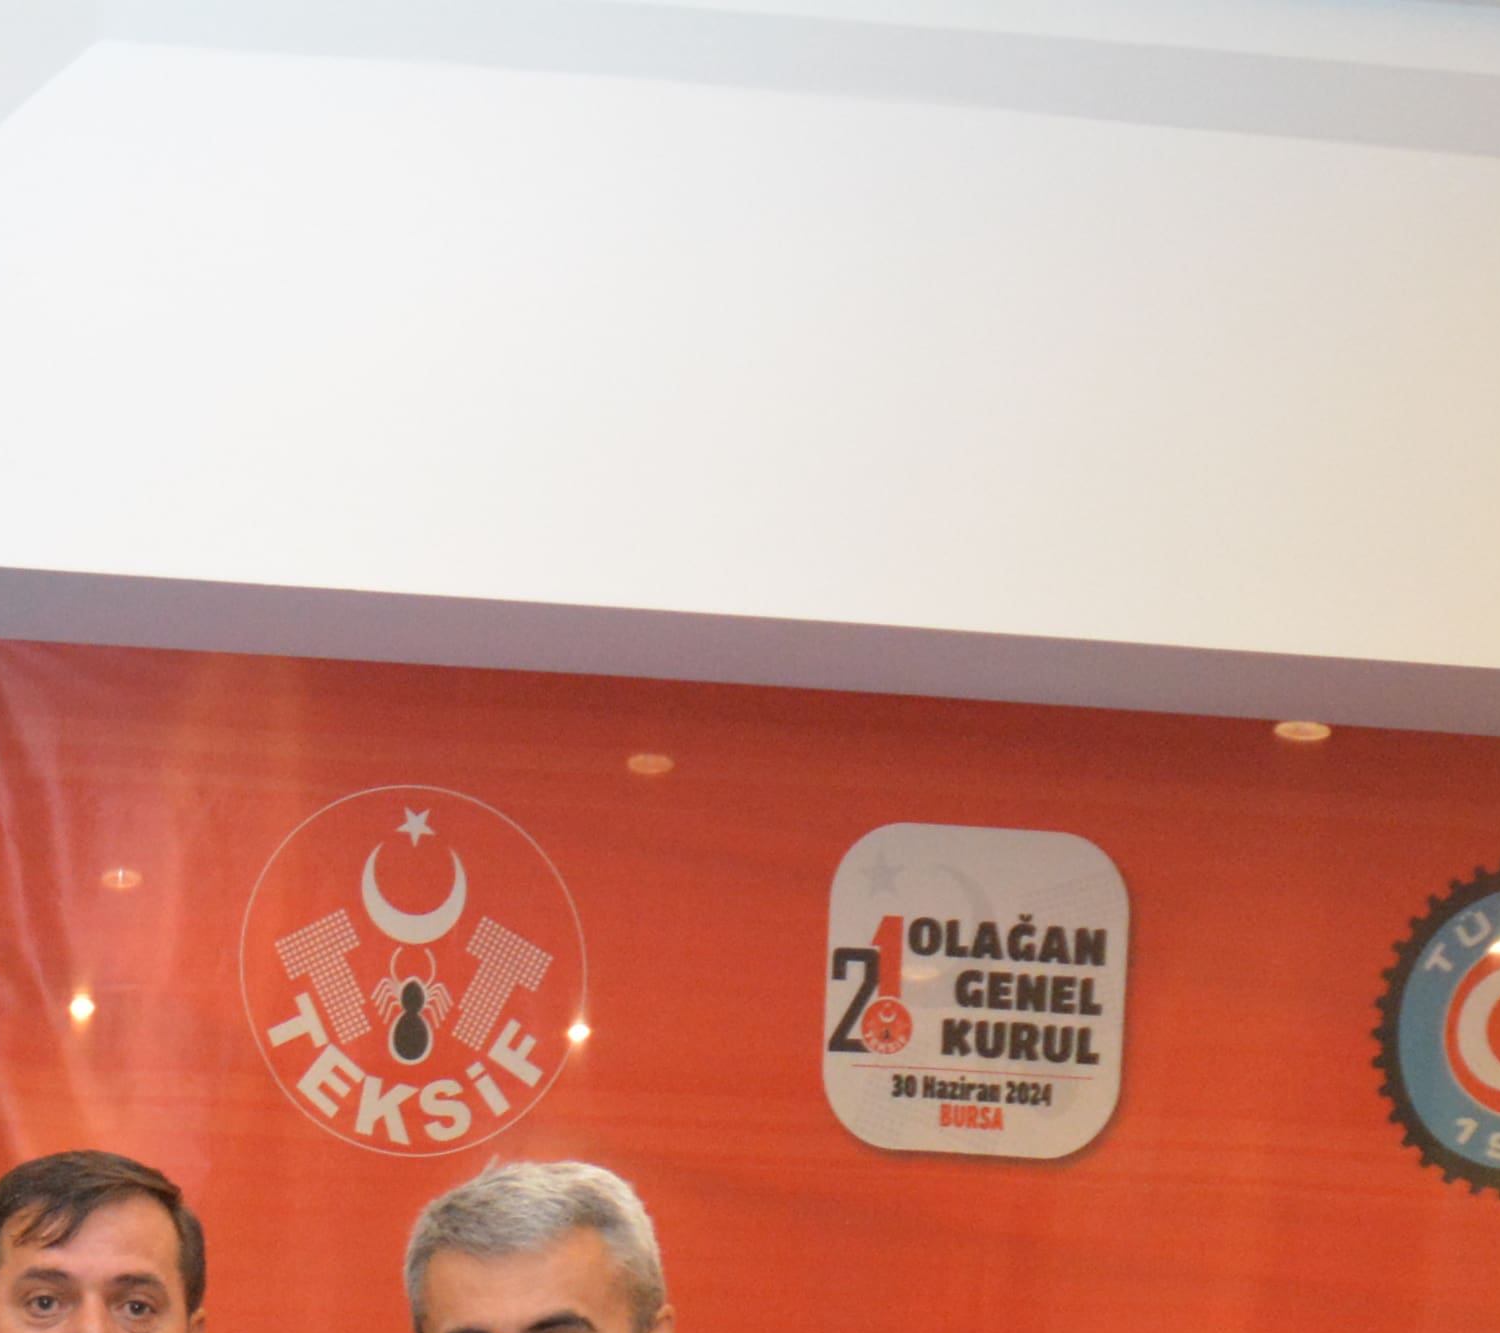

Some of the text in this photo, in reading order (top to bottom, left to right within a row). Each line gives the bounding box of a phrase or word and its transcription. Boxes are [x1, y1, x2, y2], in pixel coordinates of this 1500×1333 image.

[908, 914, 1107, 966] OLAĞAN
[955, 970, 1102, 1016] GENEL
[942, 1018, 1099, 1065] KURUL
[891, 1074, 1053, 1106] 30 Haziran 2024
[939, 1104, 1004, 1130] BURSA
